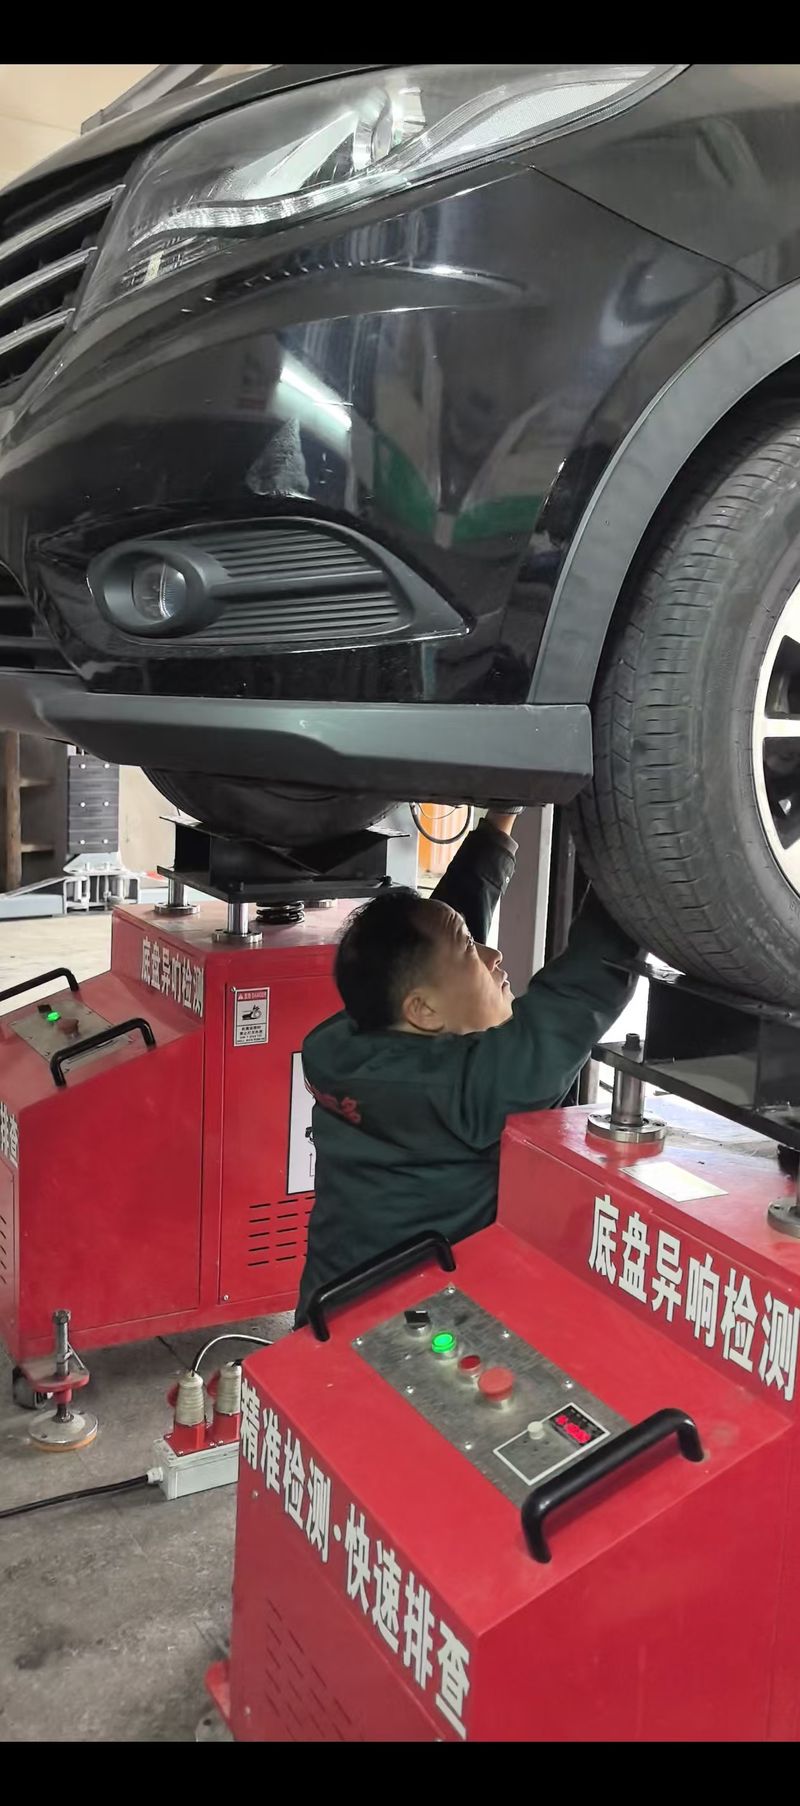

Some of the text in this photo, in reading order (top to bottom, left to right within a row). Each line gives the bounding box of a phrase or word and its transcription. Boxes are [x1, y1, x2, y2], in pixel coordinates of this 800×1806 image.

[141, 935, 204, 1018] 底盘异响检测
[588, 1194, 800, 1402] 底盘异响检测
[240, 1378, 471, 1741] 精准检测·快速排查
